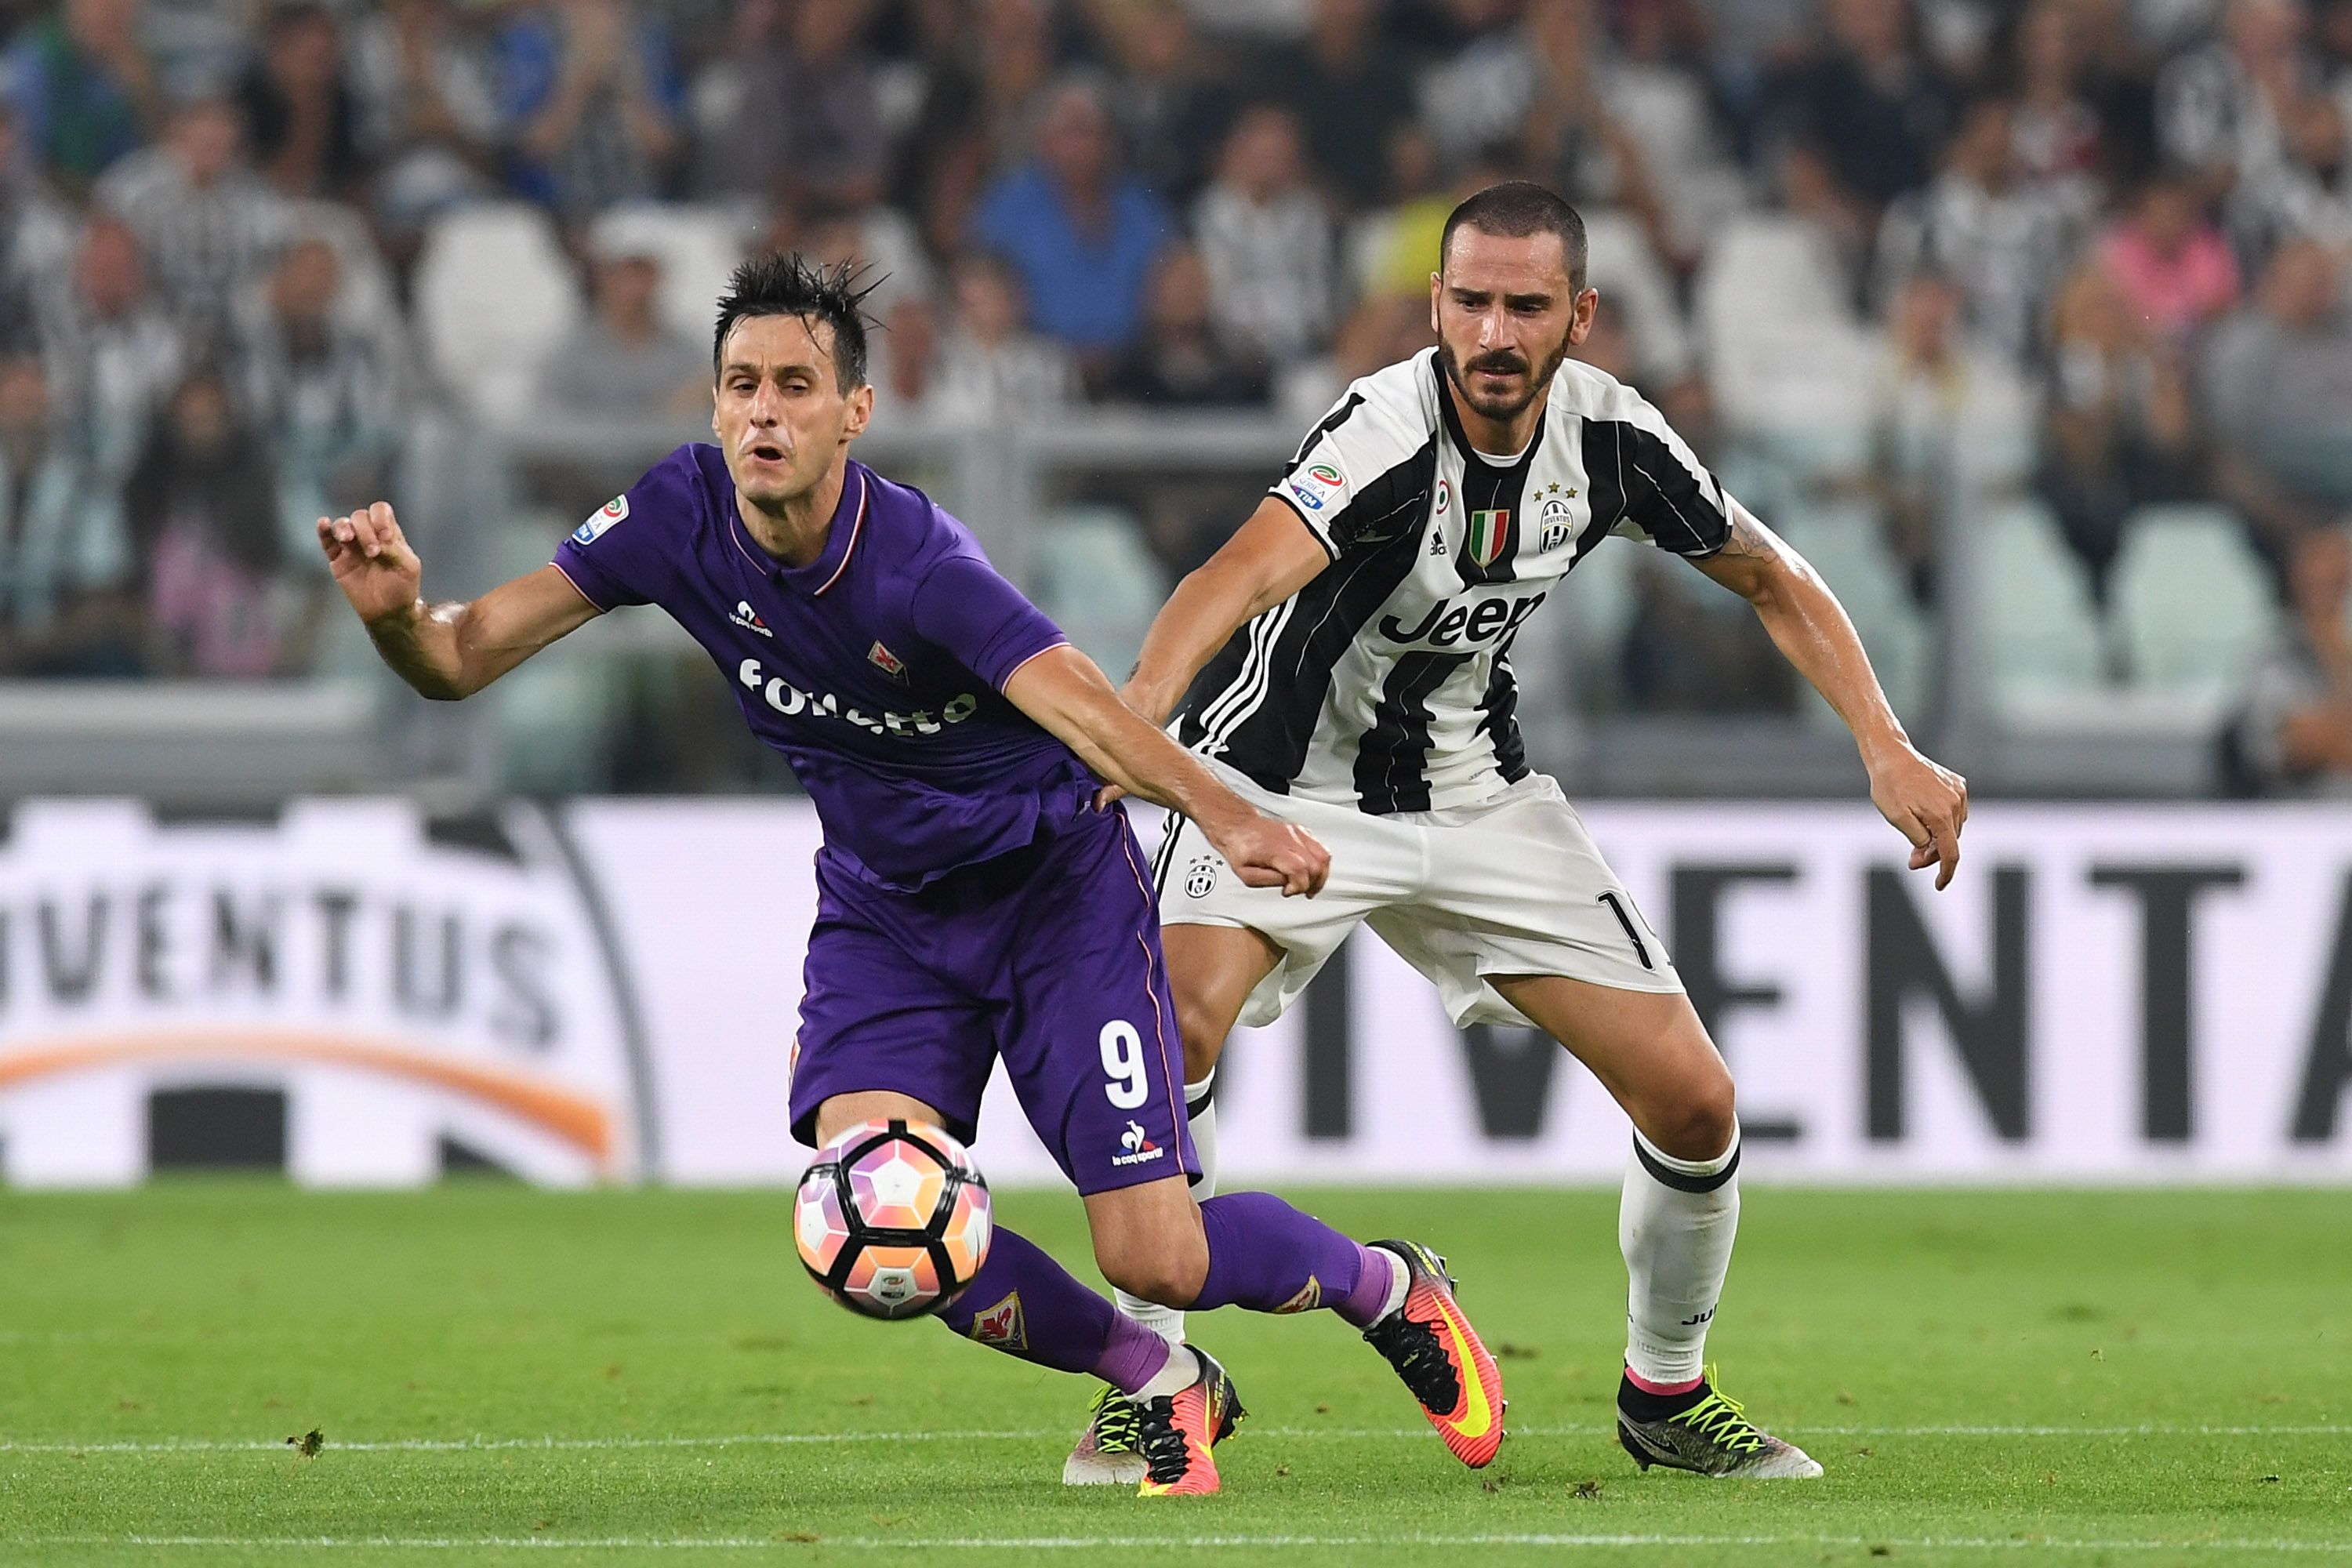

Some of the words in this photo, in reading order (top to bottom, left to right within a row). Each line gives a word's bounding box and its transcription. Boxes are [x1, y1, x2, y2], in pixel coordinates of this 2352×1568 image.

[1298, 491, 1317, 506] TIM
[1378, 591, 1547, 646] Jeep
[1595, 889, 1672, 971] 1
[0, 877, 561, 1052] VENTUS
[1099, 1019, 1149, 1110] 9
[1681, 1303, 1718, 1326] JU
